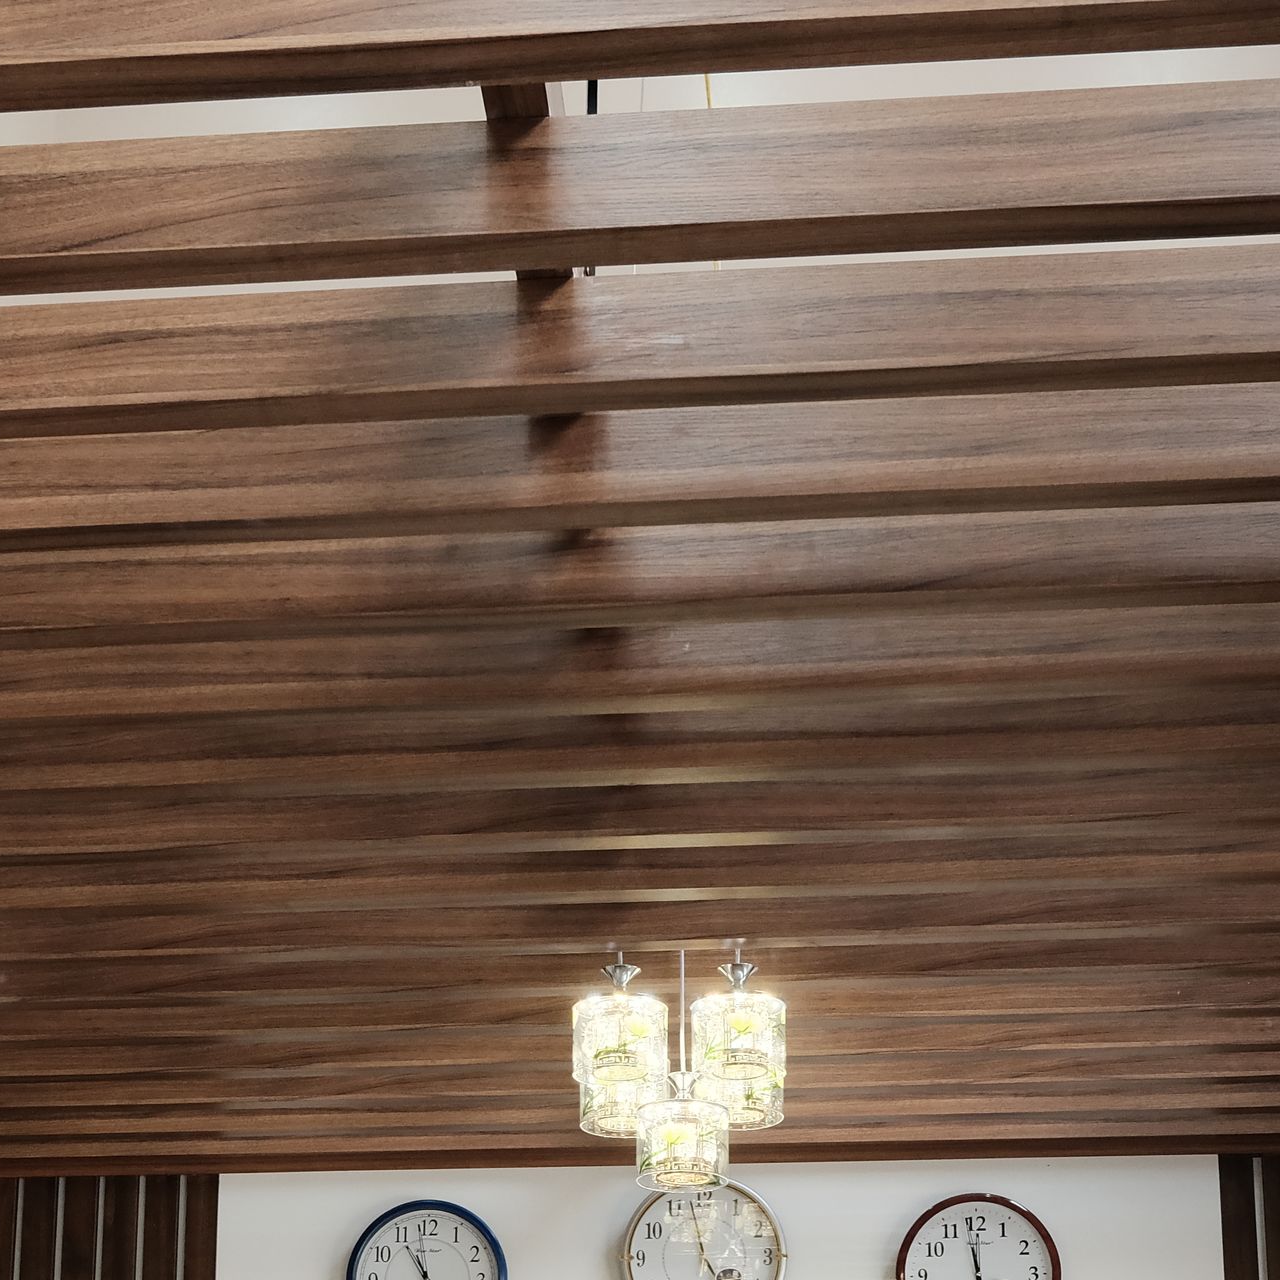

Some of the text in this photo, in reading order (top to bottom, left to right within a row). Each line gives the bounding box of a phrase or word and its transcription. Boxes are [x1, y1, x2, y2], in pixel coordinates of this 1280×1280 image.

[694, 1191, 713, 1207] 12
[732, 1199, 740, 1216] 1
[421, 1219, 438, 1236] 12
[644, 1221, 662, 1239] 10
[753, 1220, 763, 1238] 2
[942, 1223, 959, 1239] 11
[967, 1216, 987, 1232] 12
[999, 1222, 1008, 1238] 1
[395, 1226, 409, 1243] 11
[452, 1226, 460, 1243] 1
[374, 1245, 391, 1263] 10
[470, 1245, 480, 1263] 2
[763, 1248, 773, 1265] 3
[926, 1241, 944, 1258] 10
[1019, 1240, 1030, 1256] 2
[636, 1250, 646, 1267] 9
